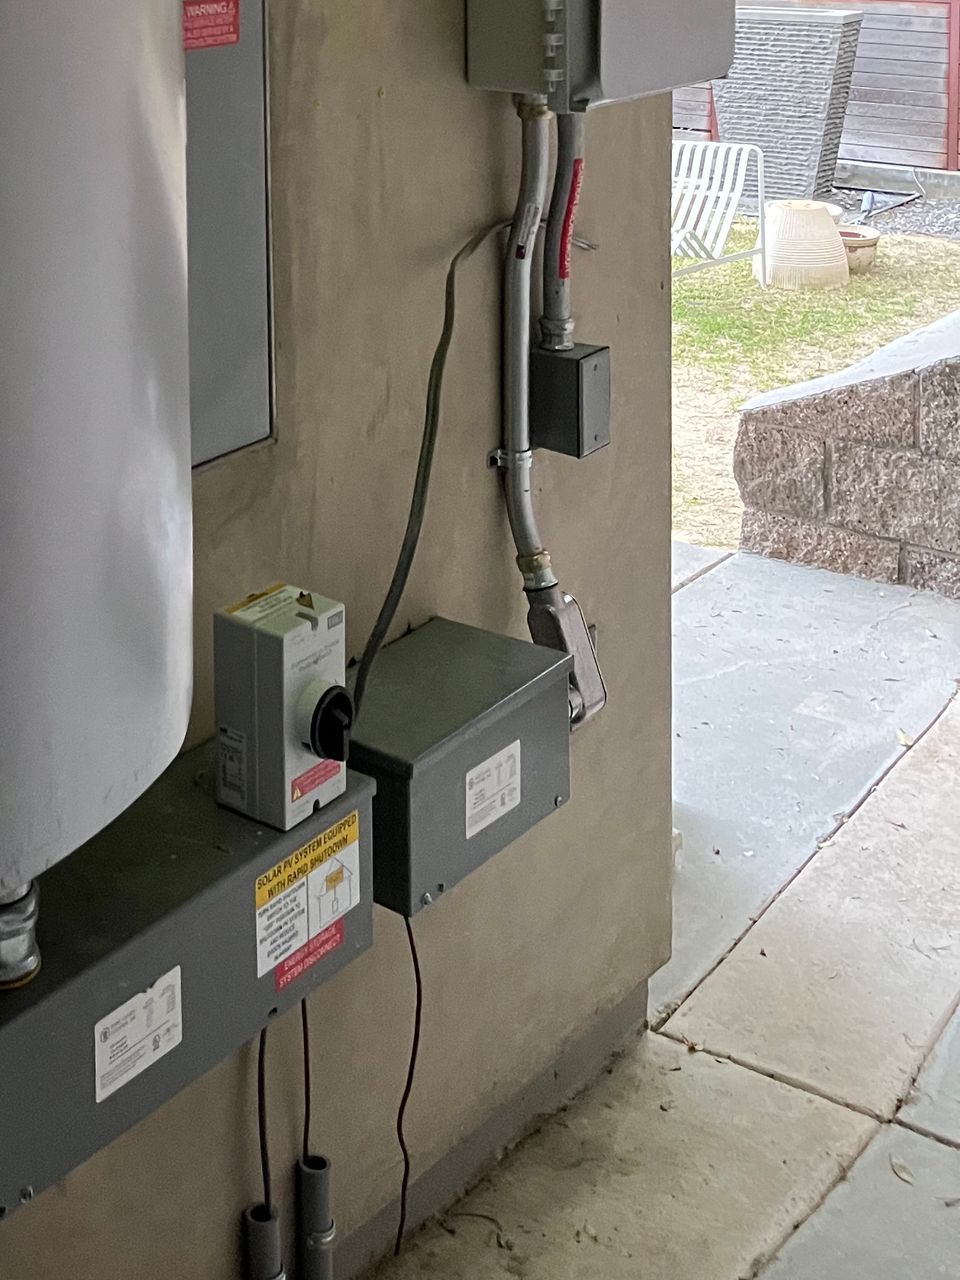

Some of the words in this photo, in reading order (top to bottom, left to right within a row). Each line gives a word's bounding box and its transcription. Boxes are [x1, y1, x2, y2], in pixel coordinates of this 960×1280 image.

[185, 2, 228, 17] WARNING
[257, 864, 282, 890] SOLAR
[284, 856, 293, 871] PV
[294, 838, 322, 865] SYSTEM
[323, 813, 357, 847] EQUIPPED
[268, 878, 286, 899] WITH
[287, 862, 309, 884] RAPID
[310, 835, 348, 870] SHUTDOWN
[279, 960, 302, 988] SYSTEM
